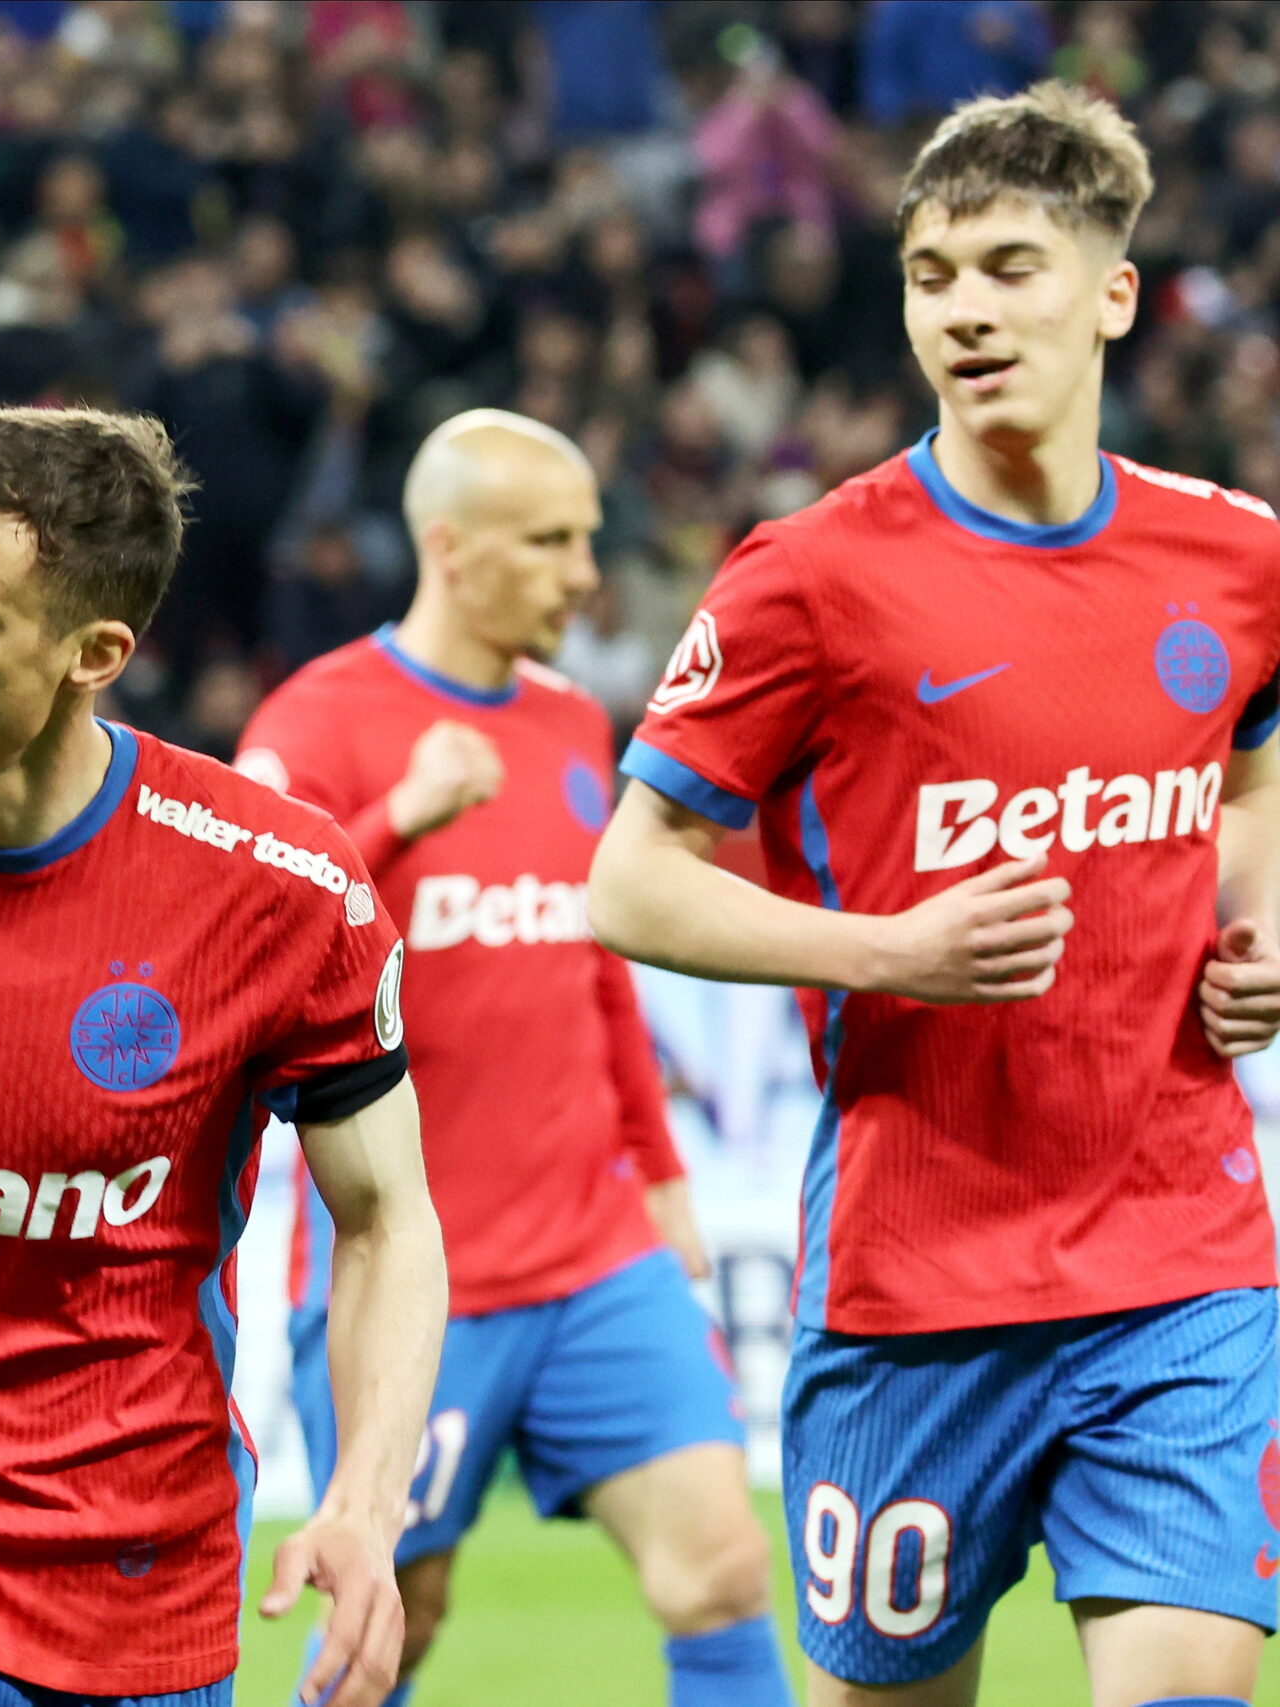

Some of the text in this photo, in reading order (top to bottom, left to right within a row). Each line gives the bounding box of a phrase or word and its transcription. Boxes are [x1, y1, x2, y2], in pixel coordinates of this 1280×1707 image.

[136, 783, 348, 895] walter tosto
[914, 761, 1223, 872] Betano
[403, 1408, 468, 1529] 1
[804, 1480, 953, 1640] 90
